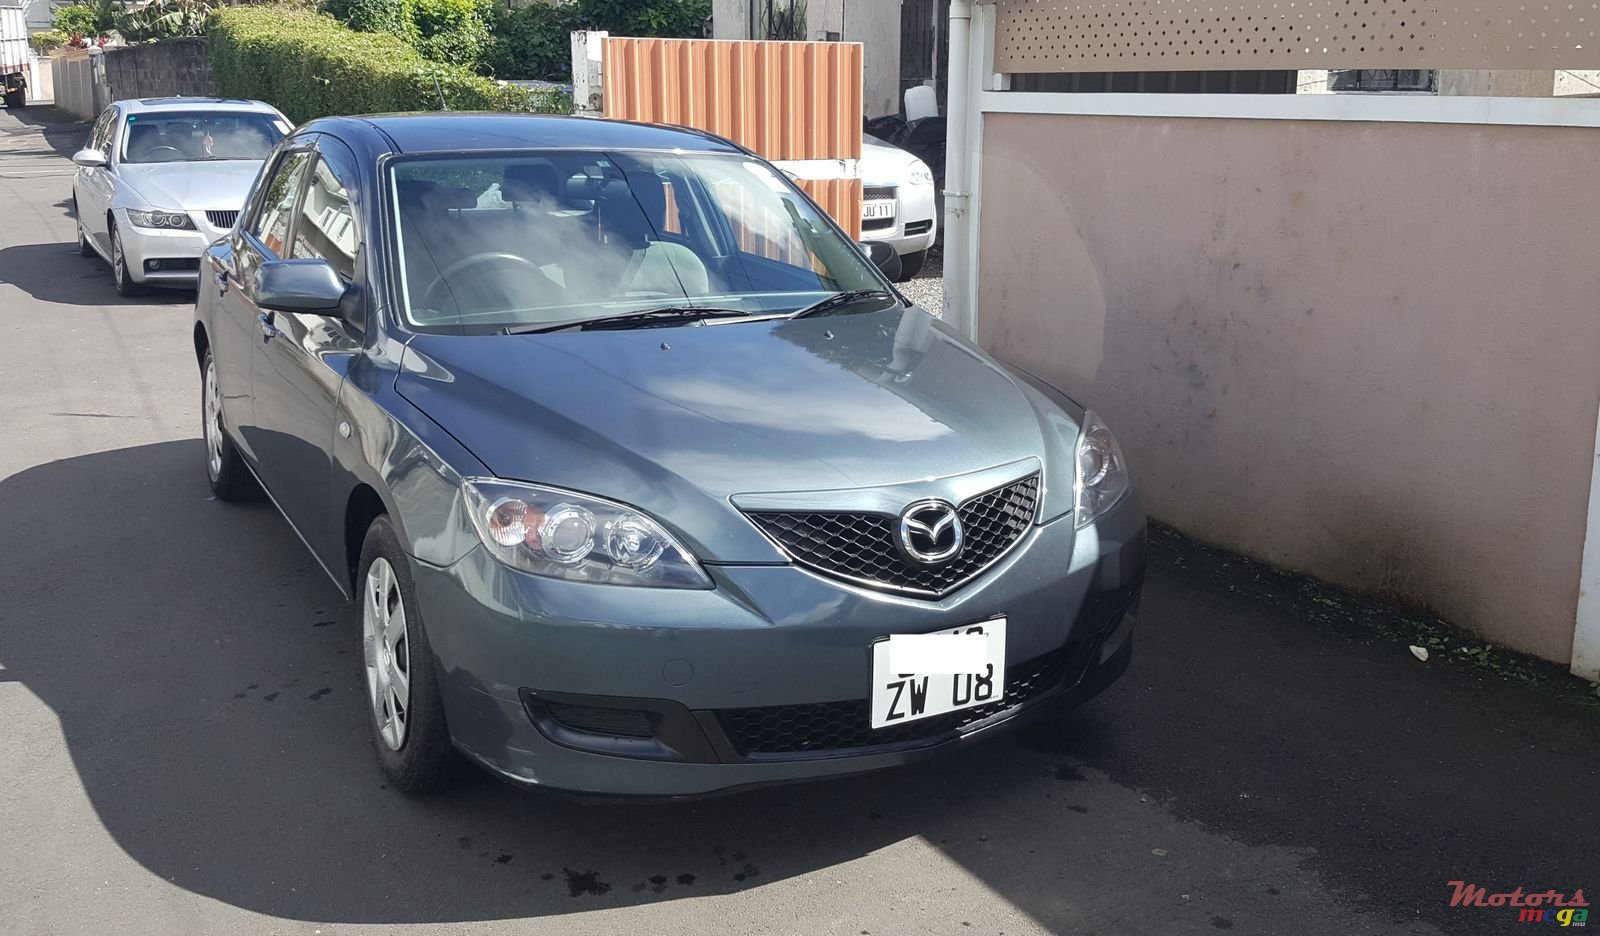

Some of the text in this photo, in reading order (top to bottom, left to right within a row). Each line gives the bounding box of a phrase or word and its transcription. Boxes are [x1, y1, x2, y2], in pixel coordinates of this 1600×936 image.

[863, 205, 888, 217] JU 11
[886, 676, 929, 721] ZW
